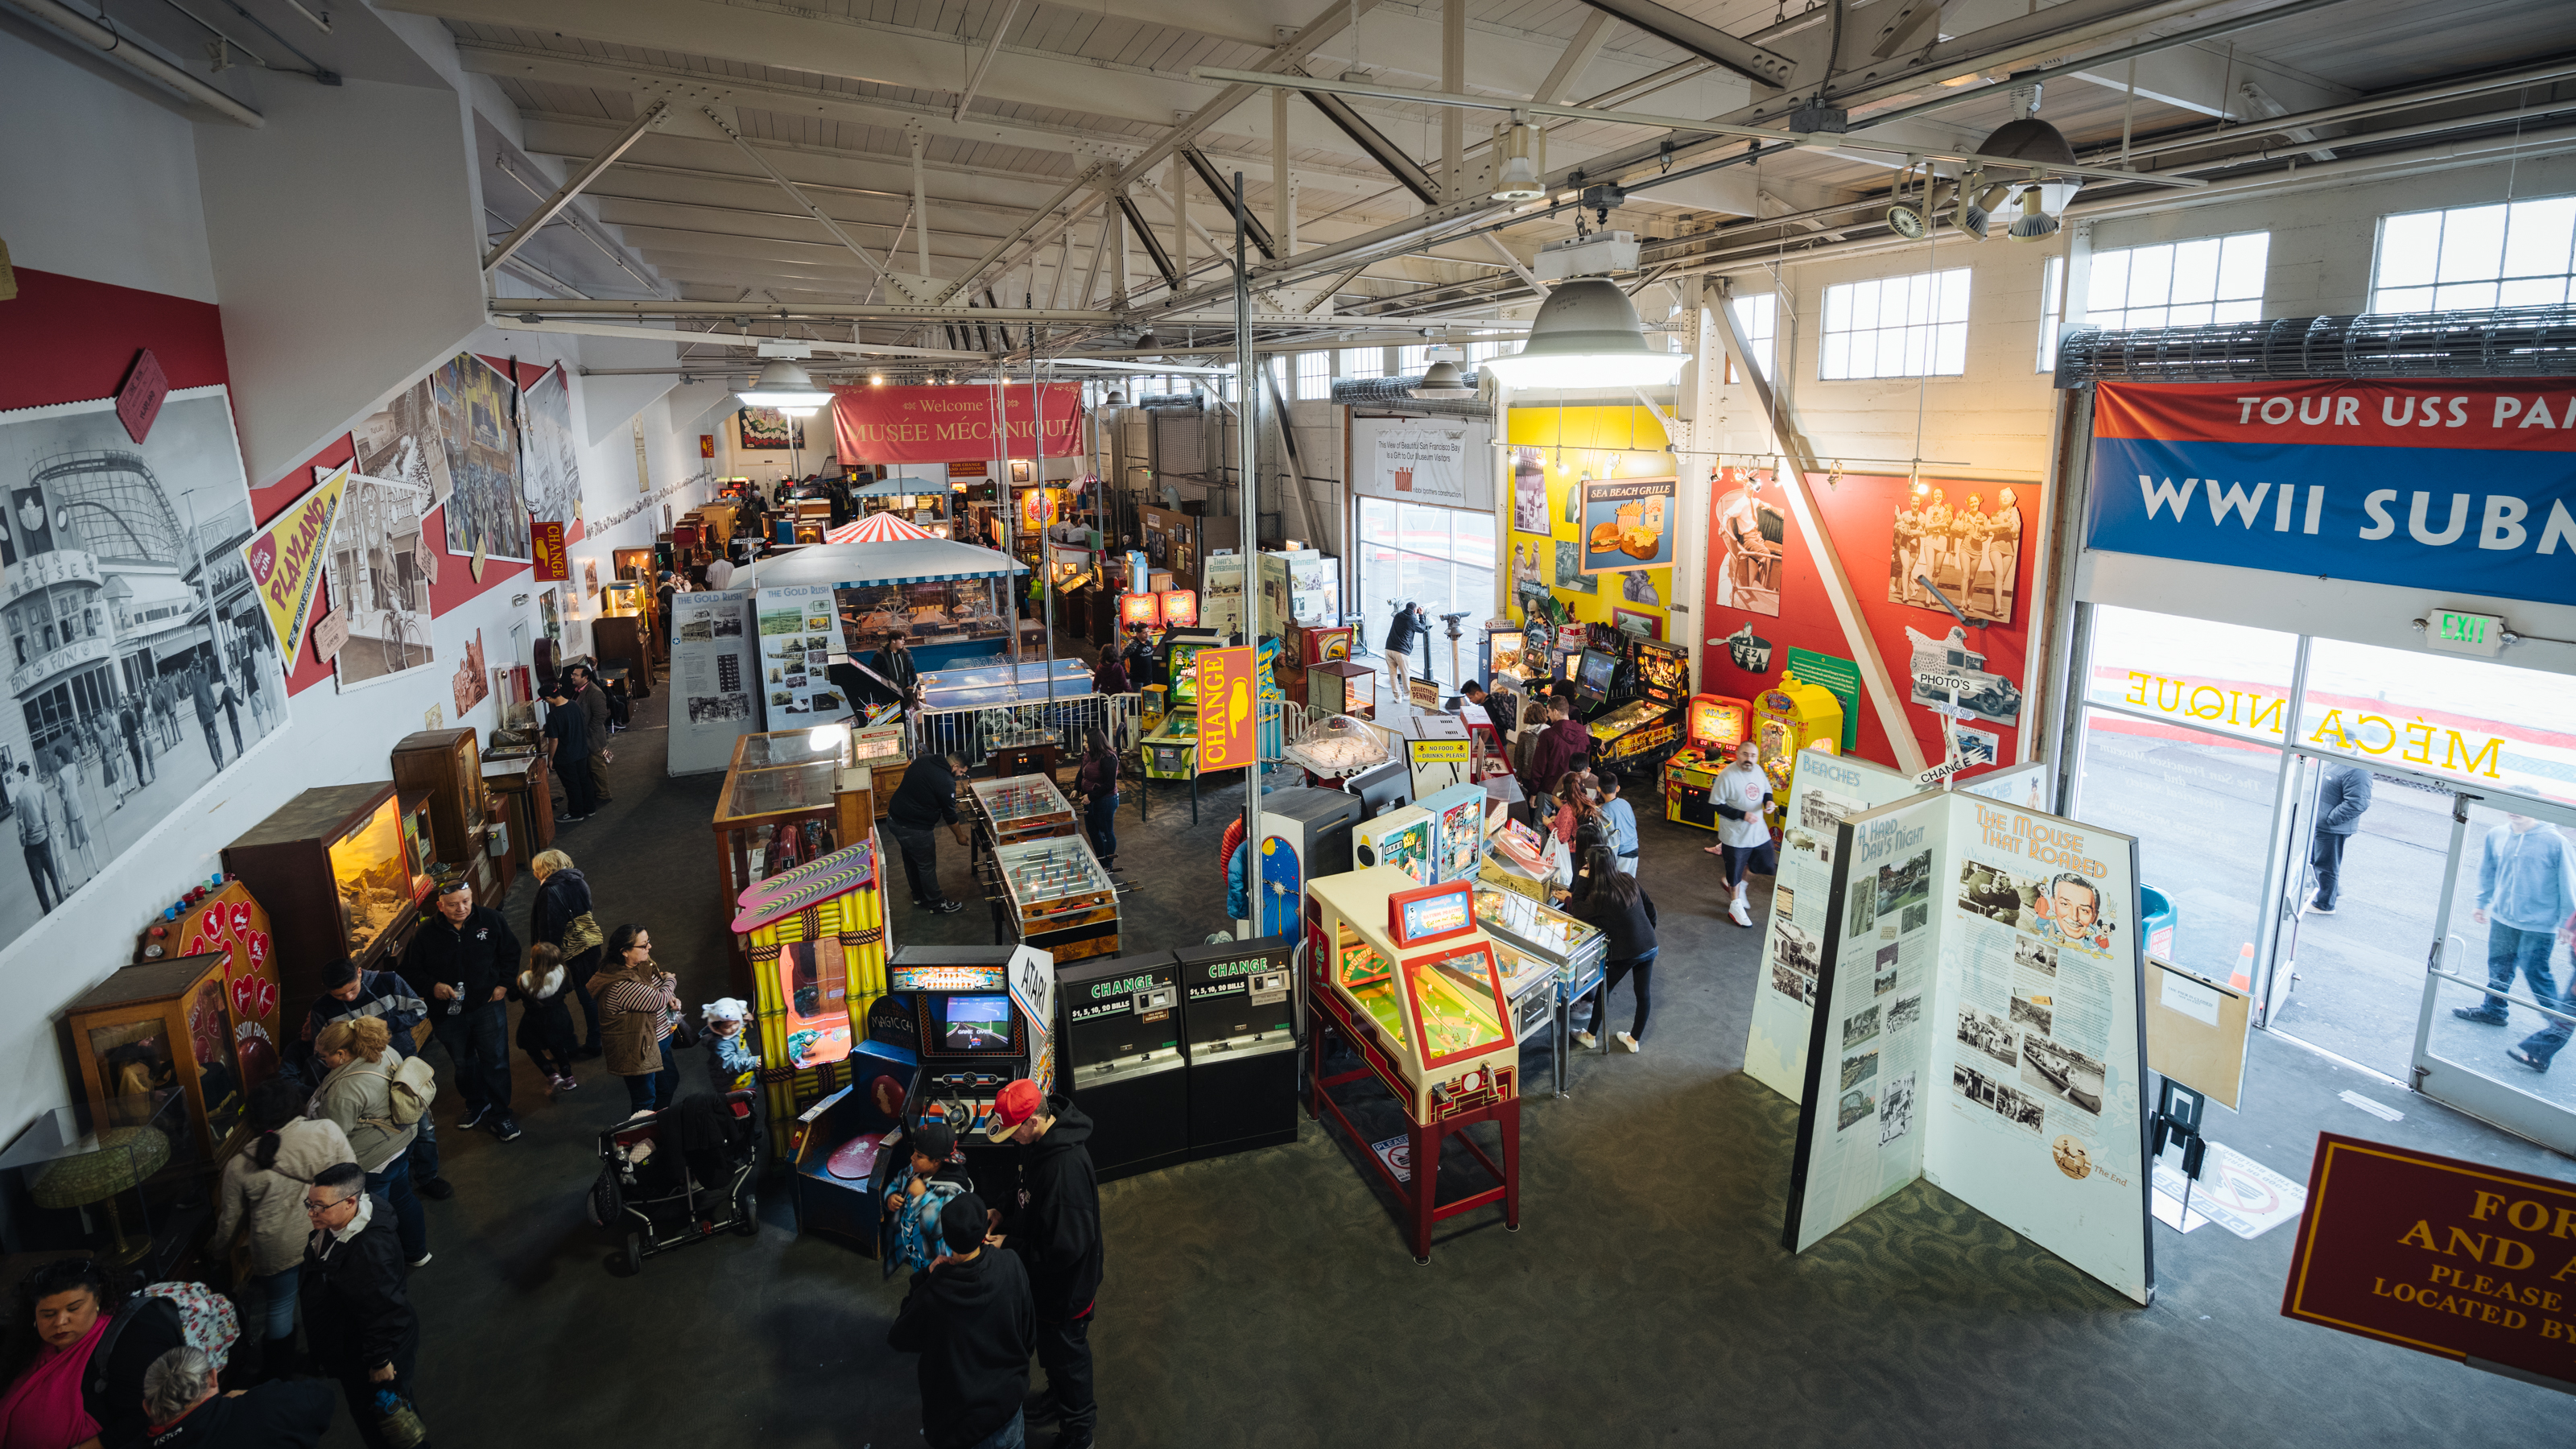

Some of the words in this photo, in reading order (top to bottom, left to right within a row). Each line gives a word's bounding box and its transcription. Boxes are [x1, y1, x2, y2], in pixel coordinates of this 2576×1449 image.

[920, 400, 983, 412] Welcome
[987, 398, 1001, 411] To
[2238, 397, 2360, 425] TOUR
[2382, 397, 2467, 427] USS
[845, 418, 929, 442] MUSÉE
[935, 416, 1074, 441] MÉCANIQUE
[1420, 442, 1428, 450] San
[1430, 443, 1450, 451] Francisco
[1451, 444, 1460, 453] Bay
[1435, 453, 1451, 462] Visitors
[1395, 467, 1413, 492] nibbi
[1423, 488, 1437, 496] brothers
[1438, 489, 1461, 497] construction
[1591, 489, 1608, 498] SEA
[1609, 487, 1638, 497] BEACH
[1639, 485, 1670, 495] GRILLE
[2139, 475, 2324, 535] WWII
[252, 548, 264, 569] Have
[270, 497, 324, 611] PLAYLAND
[547, 526, 564, 577] CHANGE
[22, 551, 61, 575] FUN
[259, 552, 271, 580] FUN
[289, 628, 299, 645] THE
[323, 502, 334, 528] CENTER
[10, 563, 80, 597] HOUSE
[677, 597, 691, 605] THE
[694, 593, 720, 603] GOLD
[722, 592, 742, 601] RUSH
[767, 589, 782, 598] THE
[784, 587, 807, 597] GOLD
[811, 585, 829, 595] RUSH
[2441, 614, 2489, 643] EXIT
[49, 646, 77, 671] FUN!
[10, 669, 29, 694] FUN!
[1411, 686, 1437, 698] COLLECTIBLE
[1920, 674, 1970, 691] PHOTO'S
[1412, 692, 1436, 704] PENNIES
[1016, 704, 1048, 714] BEST
[1204, 656, 1226, 764] CHANGE
[1760, 711, 1771, 719] PRIZE
[1773, 715, 1785, 723] EVERY
[1786, 719, 1796, 727] TIME
[1942, 703, 1957, 716] WW2
[1959, 708, 1973, 720] SHIP
[1962, 726, 1990, 736] RESTROOMS
[1803, 754, 1861, 787] BEACHES
[1403, 832, 1416, 843] ROAD
[1857, 824, 1867, 848] A
[1870, 819, 1898, 839] HARD
[1975, 803, 2007, 832] THE
[2013, 815, 2083, 853] MOUSE
[1404, 839, 1415, 848] RACE
[1860, 839, 1893, 864] DAY'S
[1895, 825, 1926, 851] NIGHT
[1980, 823, 2023, 854] THAT
[2029, 837, 2107, 878] ROARED
[1443, 906, 1462, 915] PRACTICE
[2153, 935, 2159, 943] NO
[2160, 930, 2171, 942] FOOD
[2153, 944, 2158, 952] OR
[2158, 940, 2170, 952] DRINK
[1208, 957, 1268, 979] CHANGE
[1022, 956, 1046, 1015] ATARI
[1091, 975, 1153, 998] CHANGE
[1190, 988, 1199, 996] $1,
[1208, 985, 1217, 993] 10,
[1227, 981, 1245, 990] BILLS
[1072, 1010, 1082, 1018] $1,
[1084, 1008, 1090, 1016] 5,
[1091, 1006, 1101, 1014] 10,
[1112, 1000, 1130, 1010] BILLS
[2194, 996, 2213, 1008] CLOSED
[871, 1016, 900, 1029] MAGIC
[901, 1019, 914, 1033] CH
[2223, 1154, 2245, 1168] DRIN
[2223, 1149, 2267, 1173] BUILDING
[2095, 1165, 2109, 1178] The
[2111, 1174, 2128, 1187] End
[2246, 1168, 2260, 1177] OR
[2269, 1174, 2289, 1187] THIS
[2262, 1176, 2289, 1192] FOOD
[2397, 1220, 2535, 1270] AND
[2428, 1264, 2562, 1312] PLEASE
[2372, 1277, 2527, 1329] LOCATED
